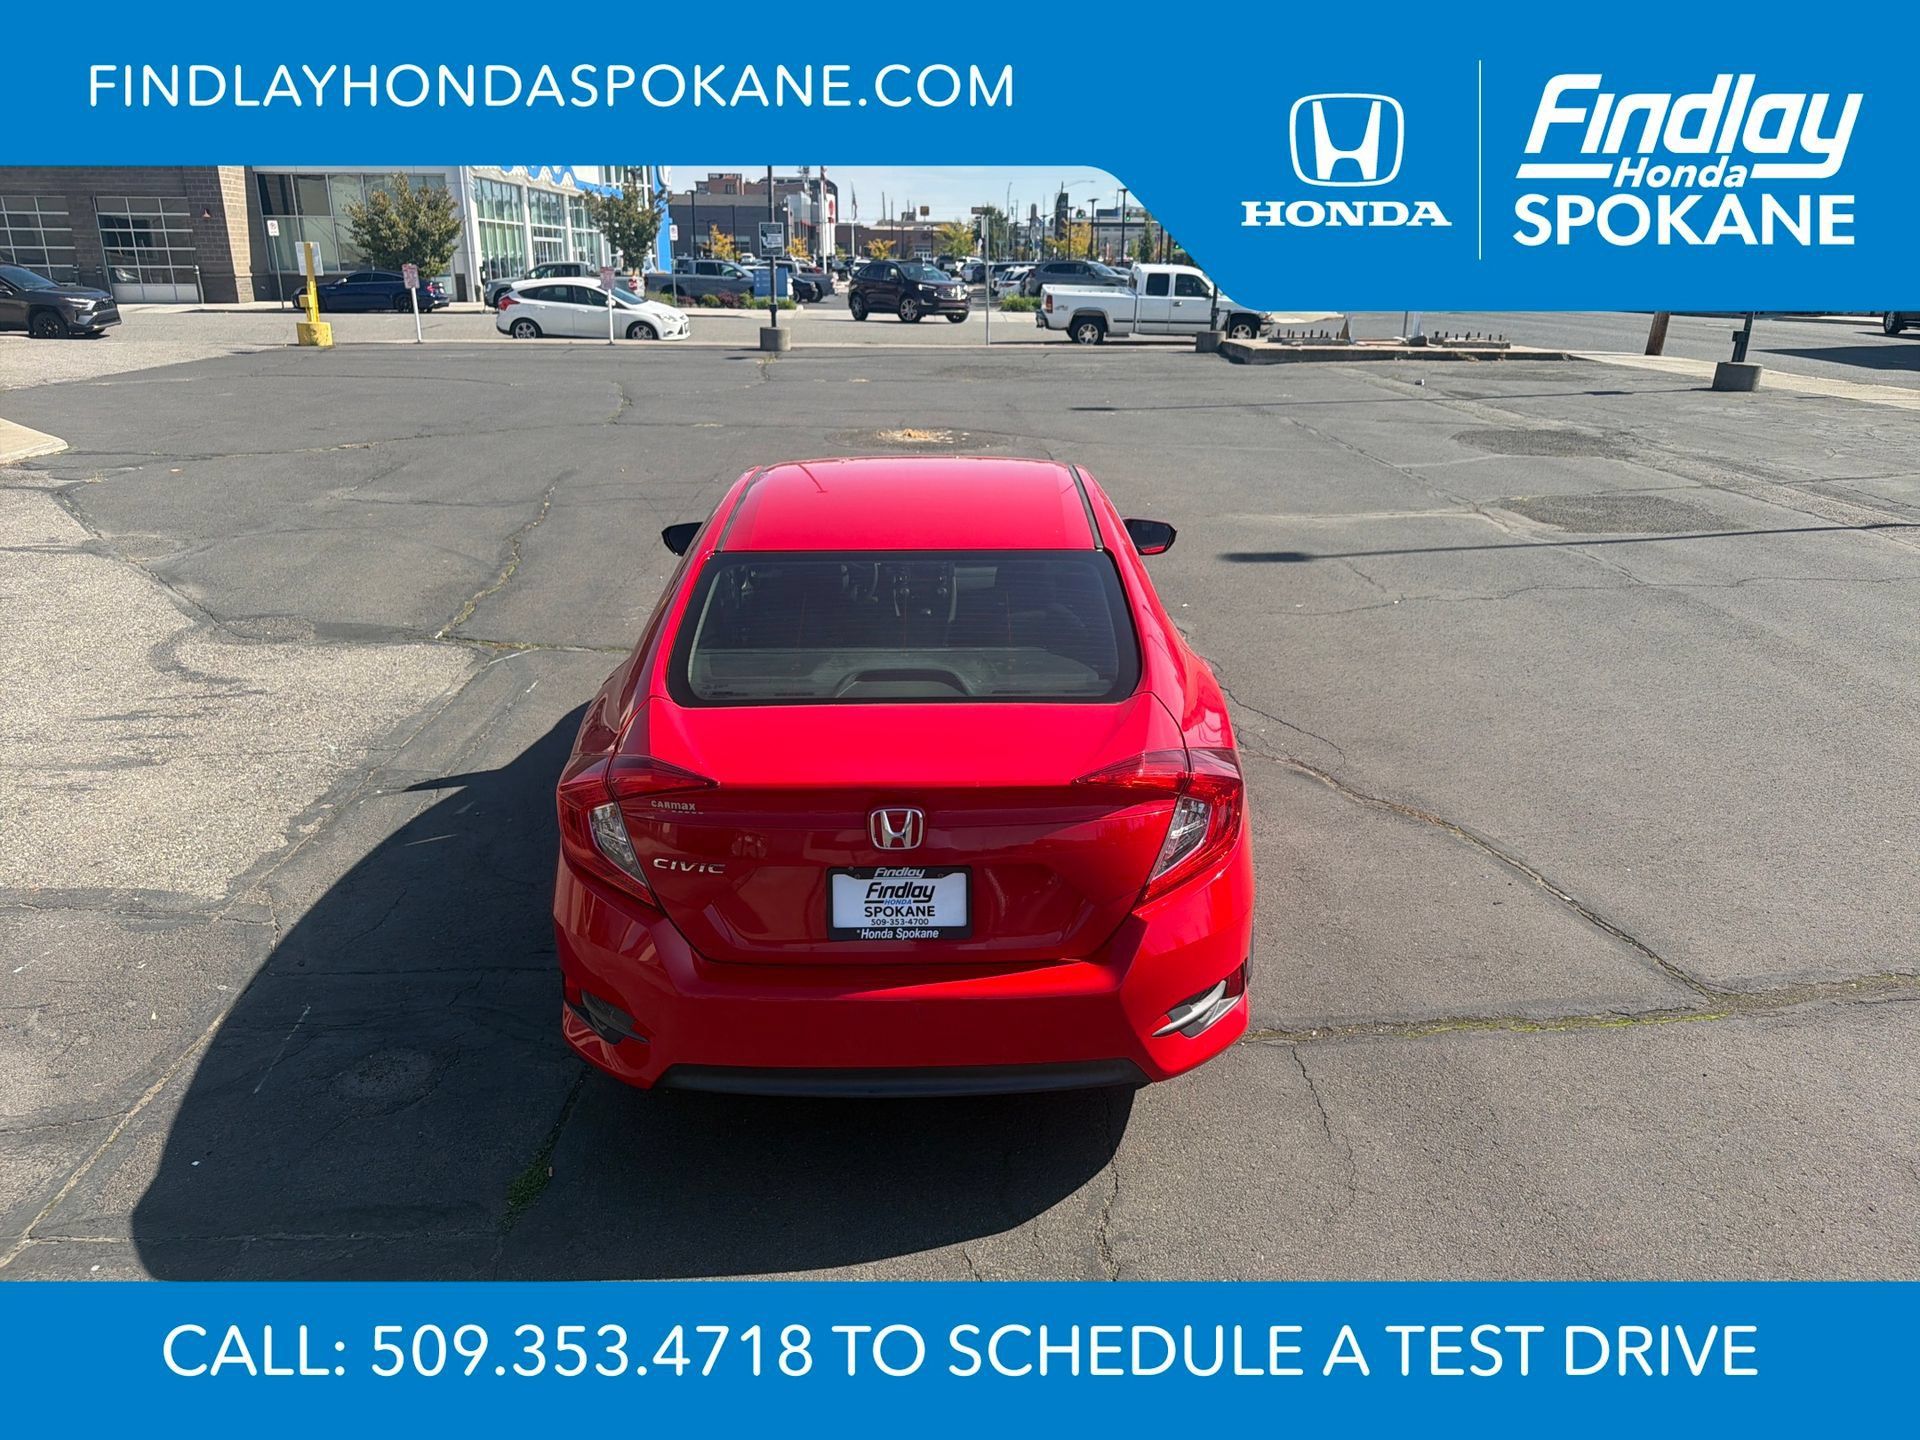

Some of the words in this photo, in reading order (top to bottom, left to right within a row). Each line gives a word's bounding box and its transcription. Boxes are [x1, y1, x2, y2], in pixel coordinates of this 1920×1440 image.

[652, 857, 726, 874] CIVIC
[873, 867, 926, 879] Findlay
[865, 881, 935, 903] Findlay
[864, 906, 936, 918] SPOKANE
[871, 918, 929, 926] 509-353-4700
[895, 928, 939, 941] Spokane
